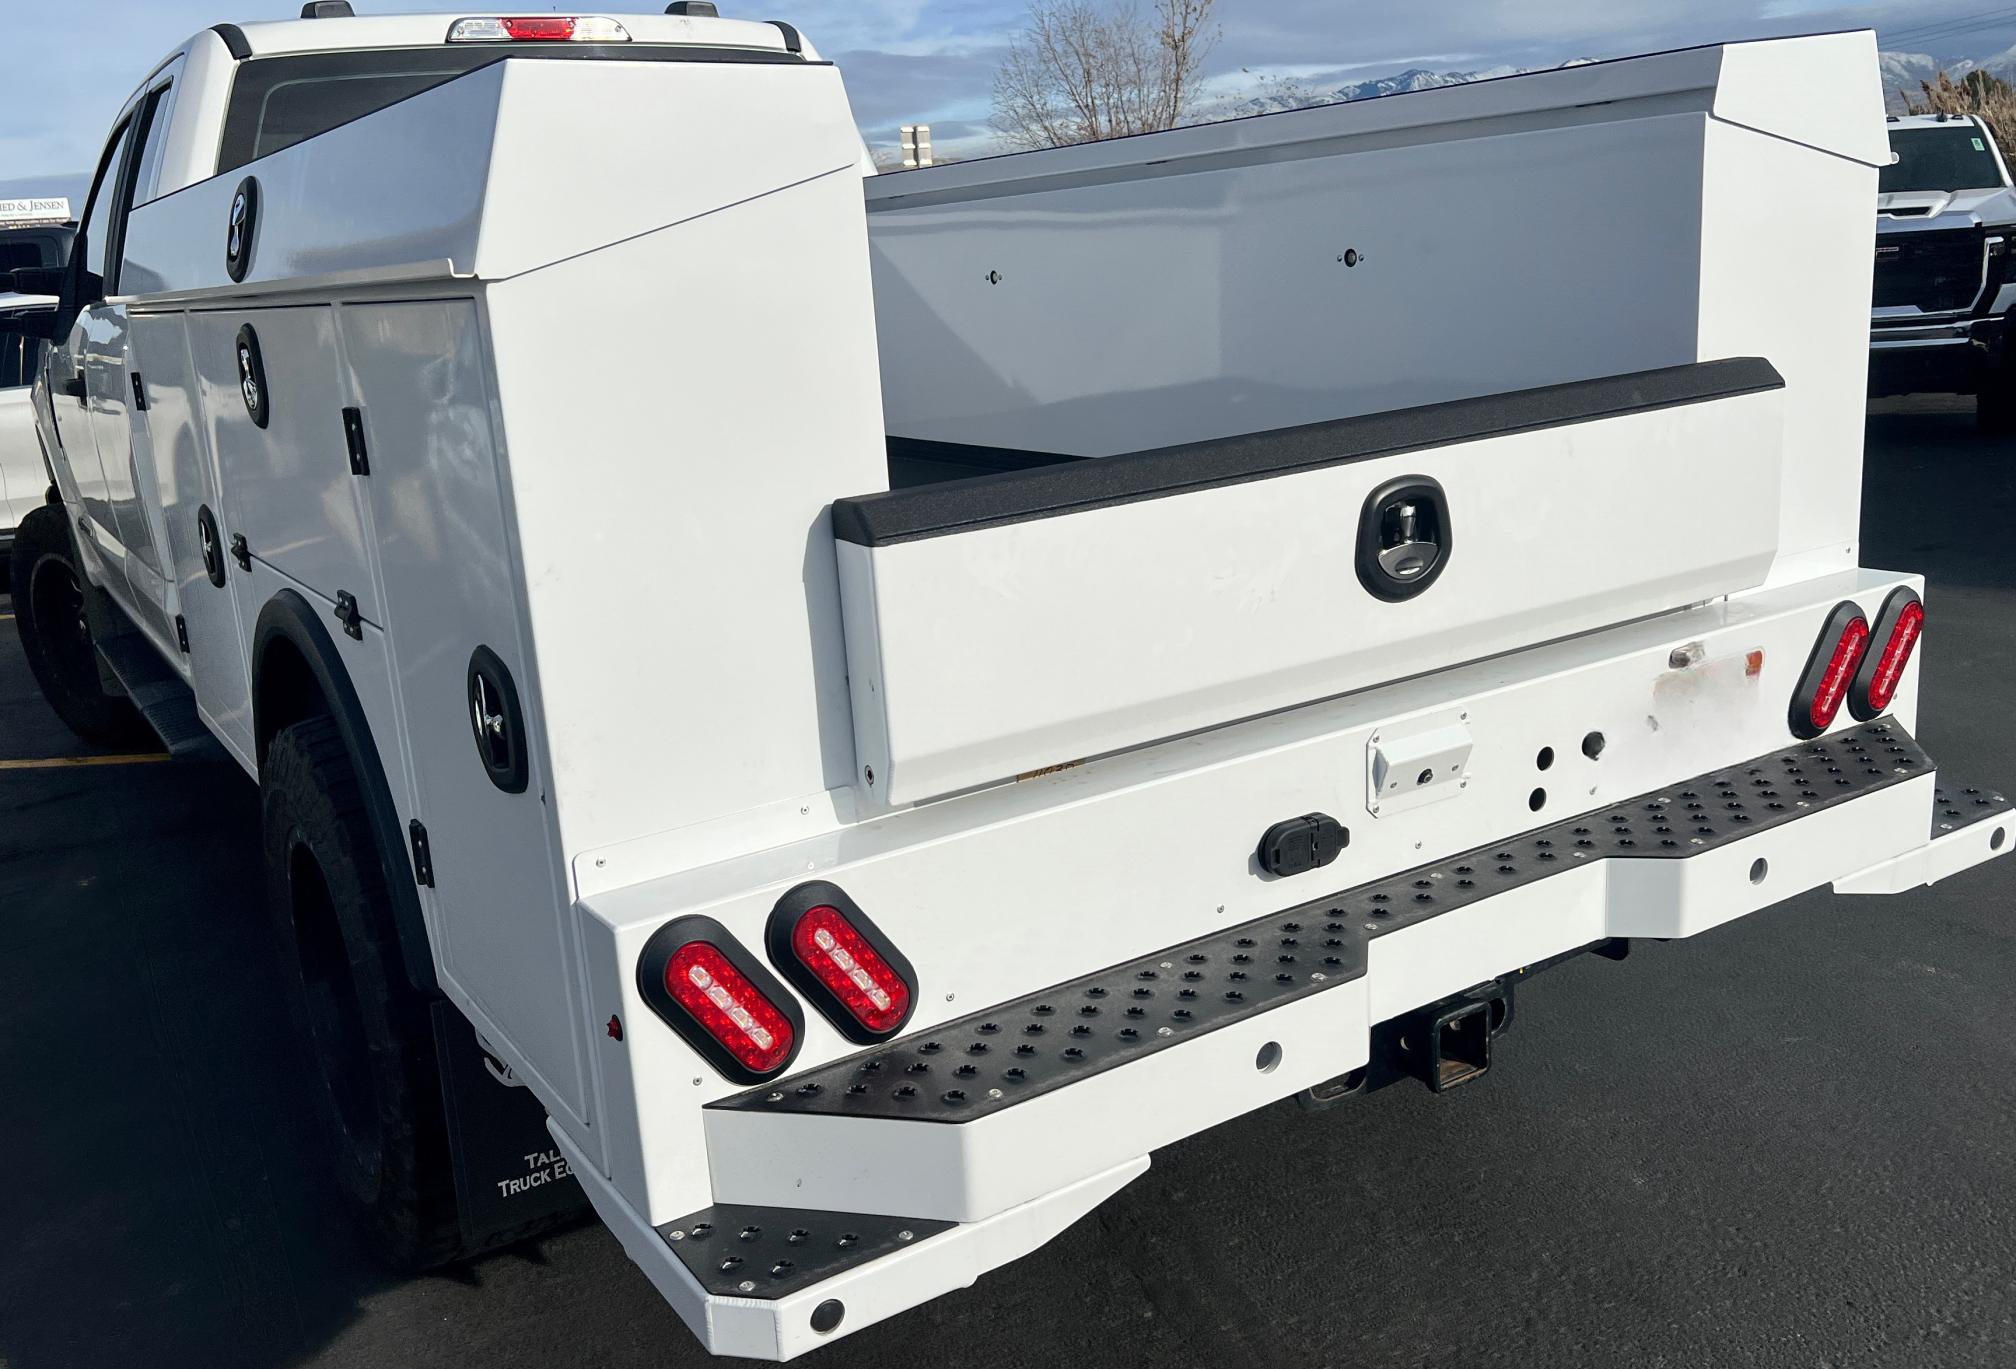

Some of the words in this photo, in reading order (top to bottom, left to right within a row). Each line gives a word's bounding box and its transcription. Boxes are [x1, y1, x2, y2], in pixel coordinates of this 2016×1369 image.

[17, 201, 27, 211] &
[29, 200, 64, 212] JENSEN
[497, 1169, 551, 1198] TRUCK
